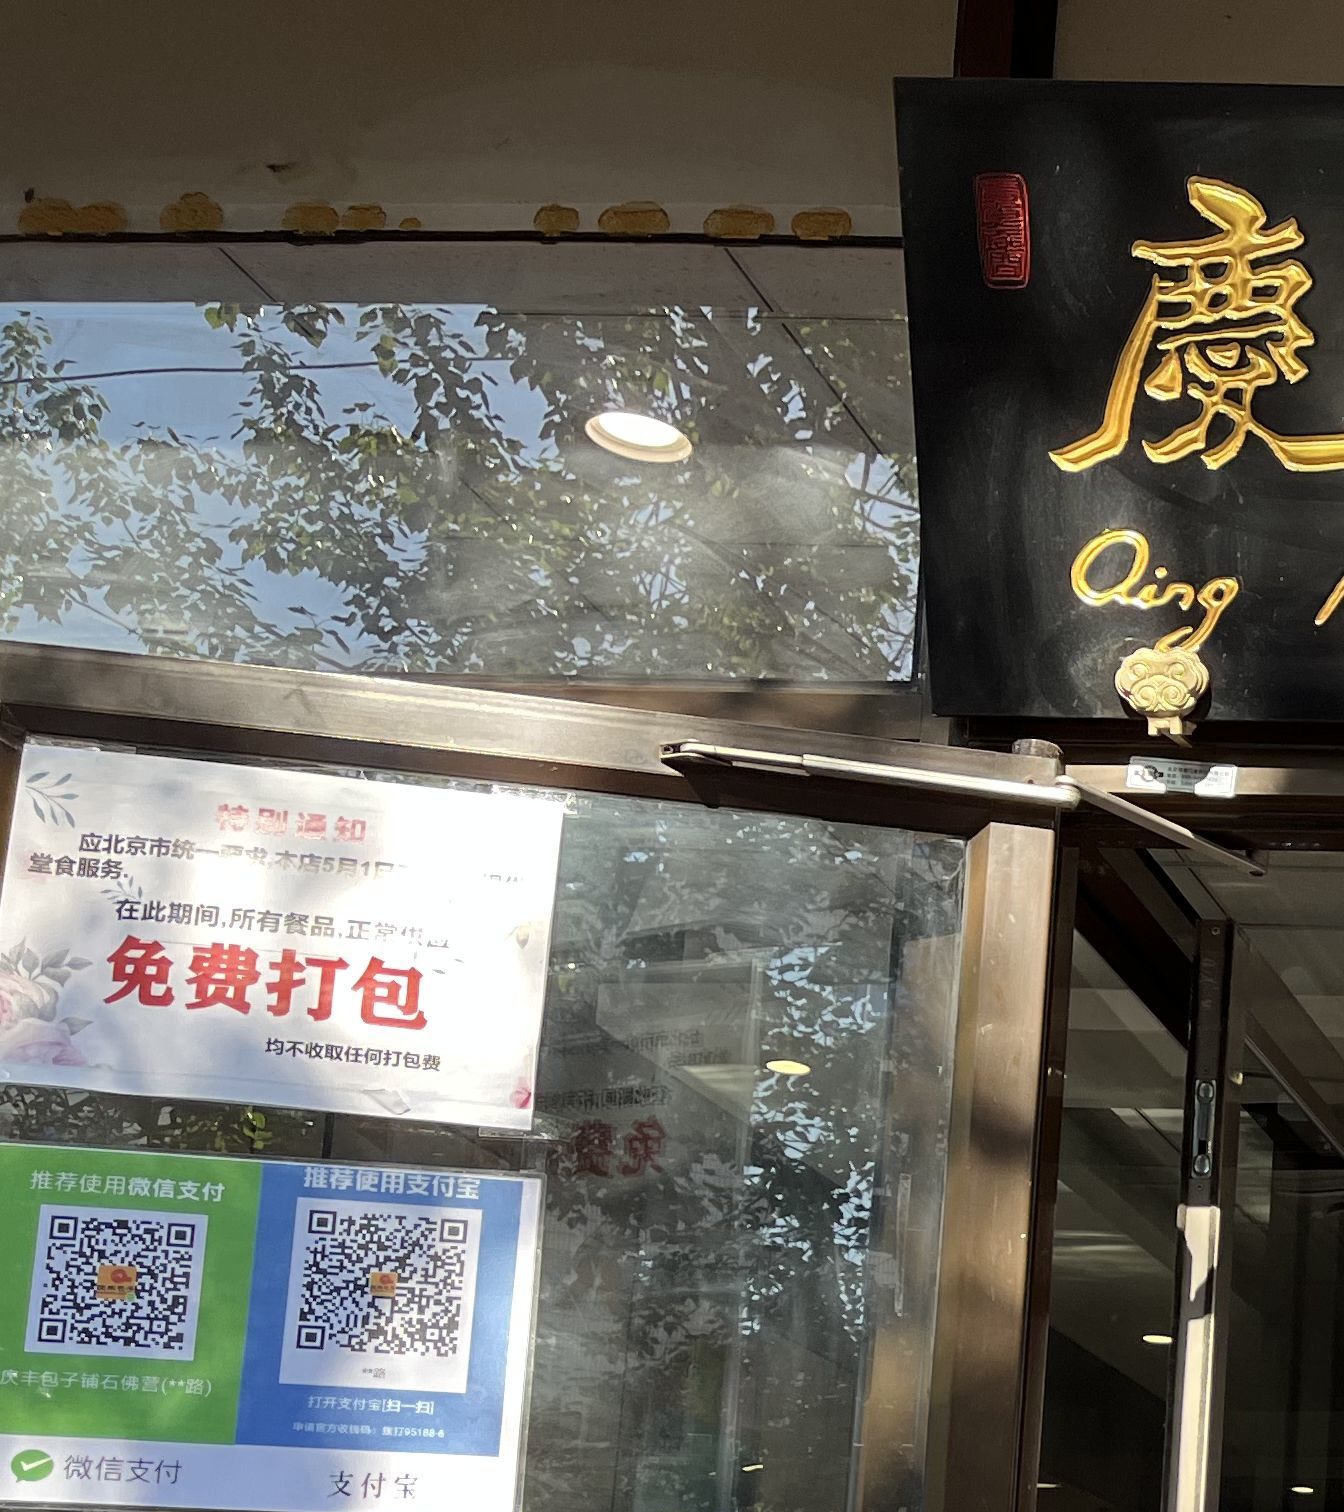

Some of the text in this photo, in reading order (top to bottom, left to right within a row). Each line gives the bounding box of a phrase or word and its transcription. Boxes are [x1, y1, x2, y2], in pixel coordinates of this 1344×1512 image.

[1070, 527, 1241, 653] Qing
[216, 803, 367, 843] 特别通知
[104, 935, 428, 1030] 免费打包
[265, 1037, 441, 1072] 均不收取任何打包费
[30, 1169, 226, 1202] 推荐使用微信支付
[303, 1165, 480, 1200] 推荐使用支付宝
[64, 1455, 182, 1485] 微信支付
[328, 1471, 418, 1500] 支付宝
